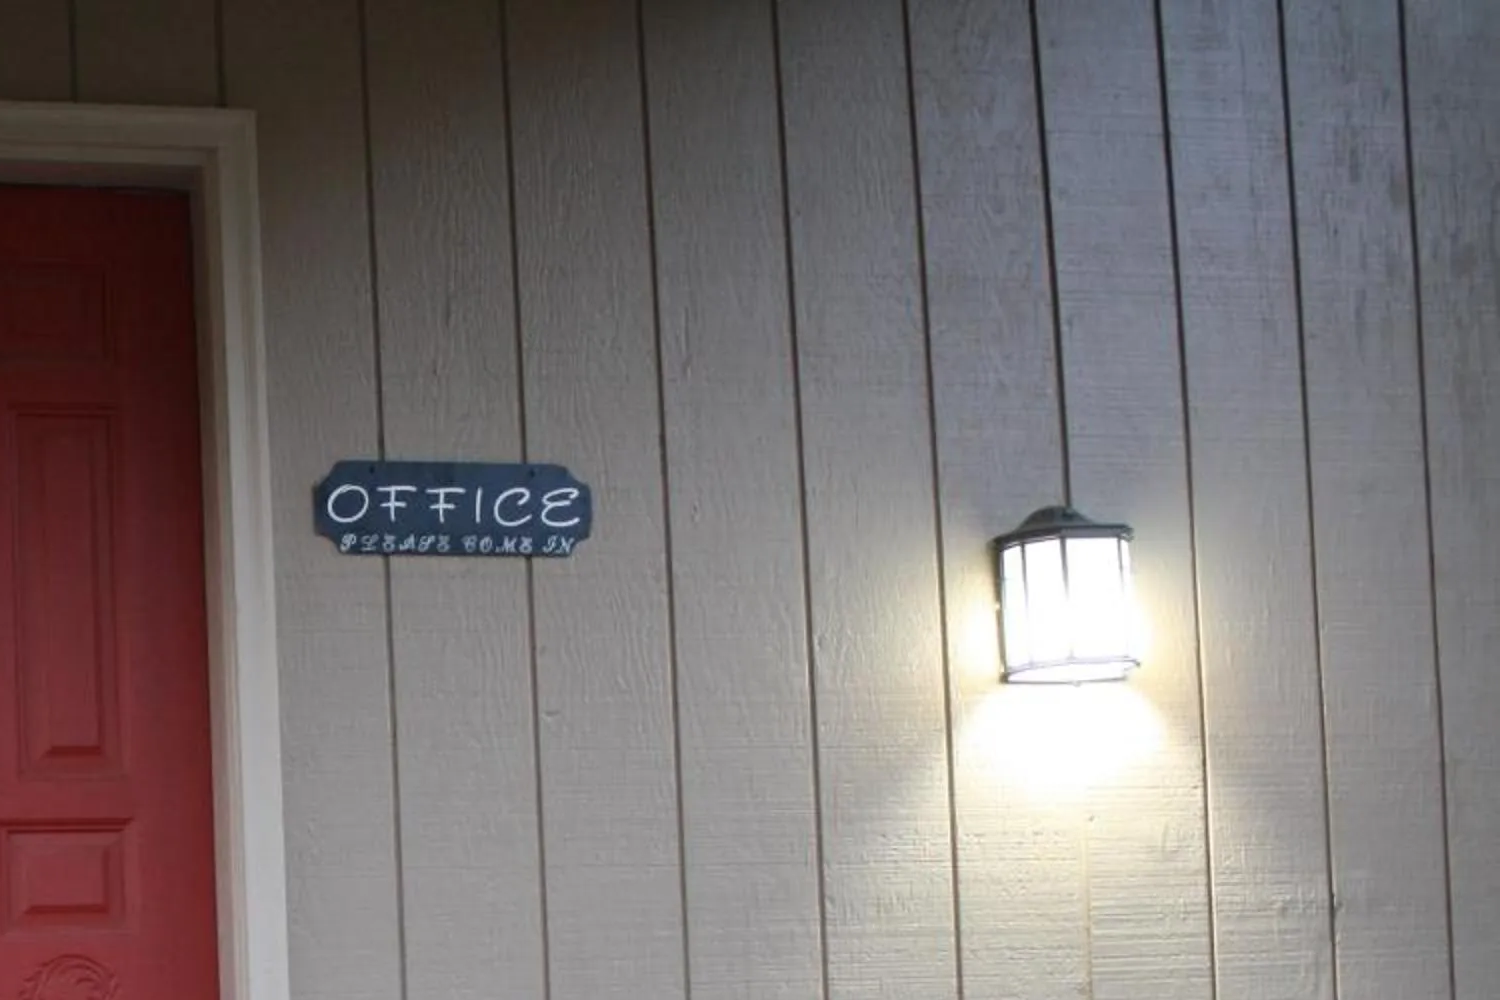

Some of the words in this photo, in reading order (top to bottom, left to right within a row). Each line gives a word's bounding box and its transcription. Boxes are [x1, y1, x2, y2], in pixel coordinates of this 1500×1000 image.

[326, 483, 581, 528] OFFICE
[340, 532, 451, 552] PLEASE
[461, 533, 533, 553] COME
[542, 536, 575, 553] IN
